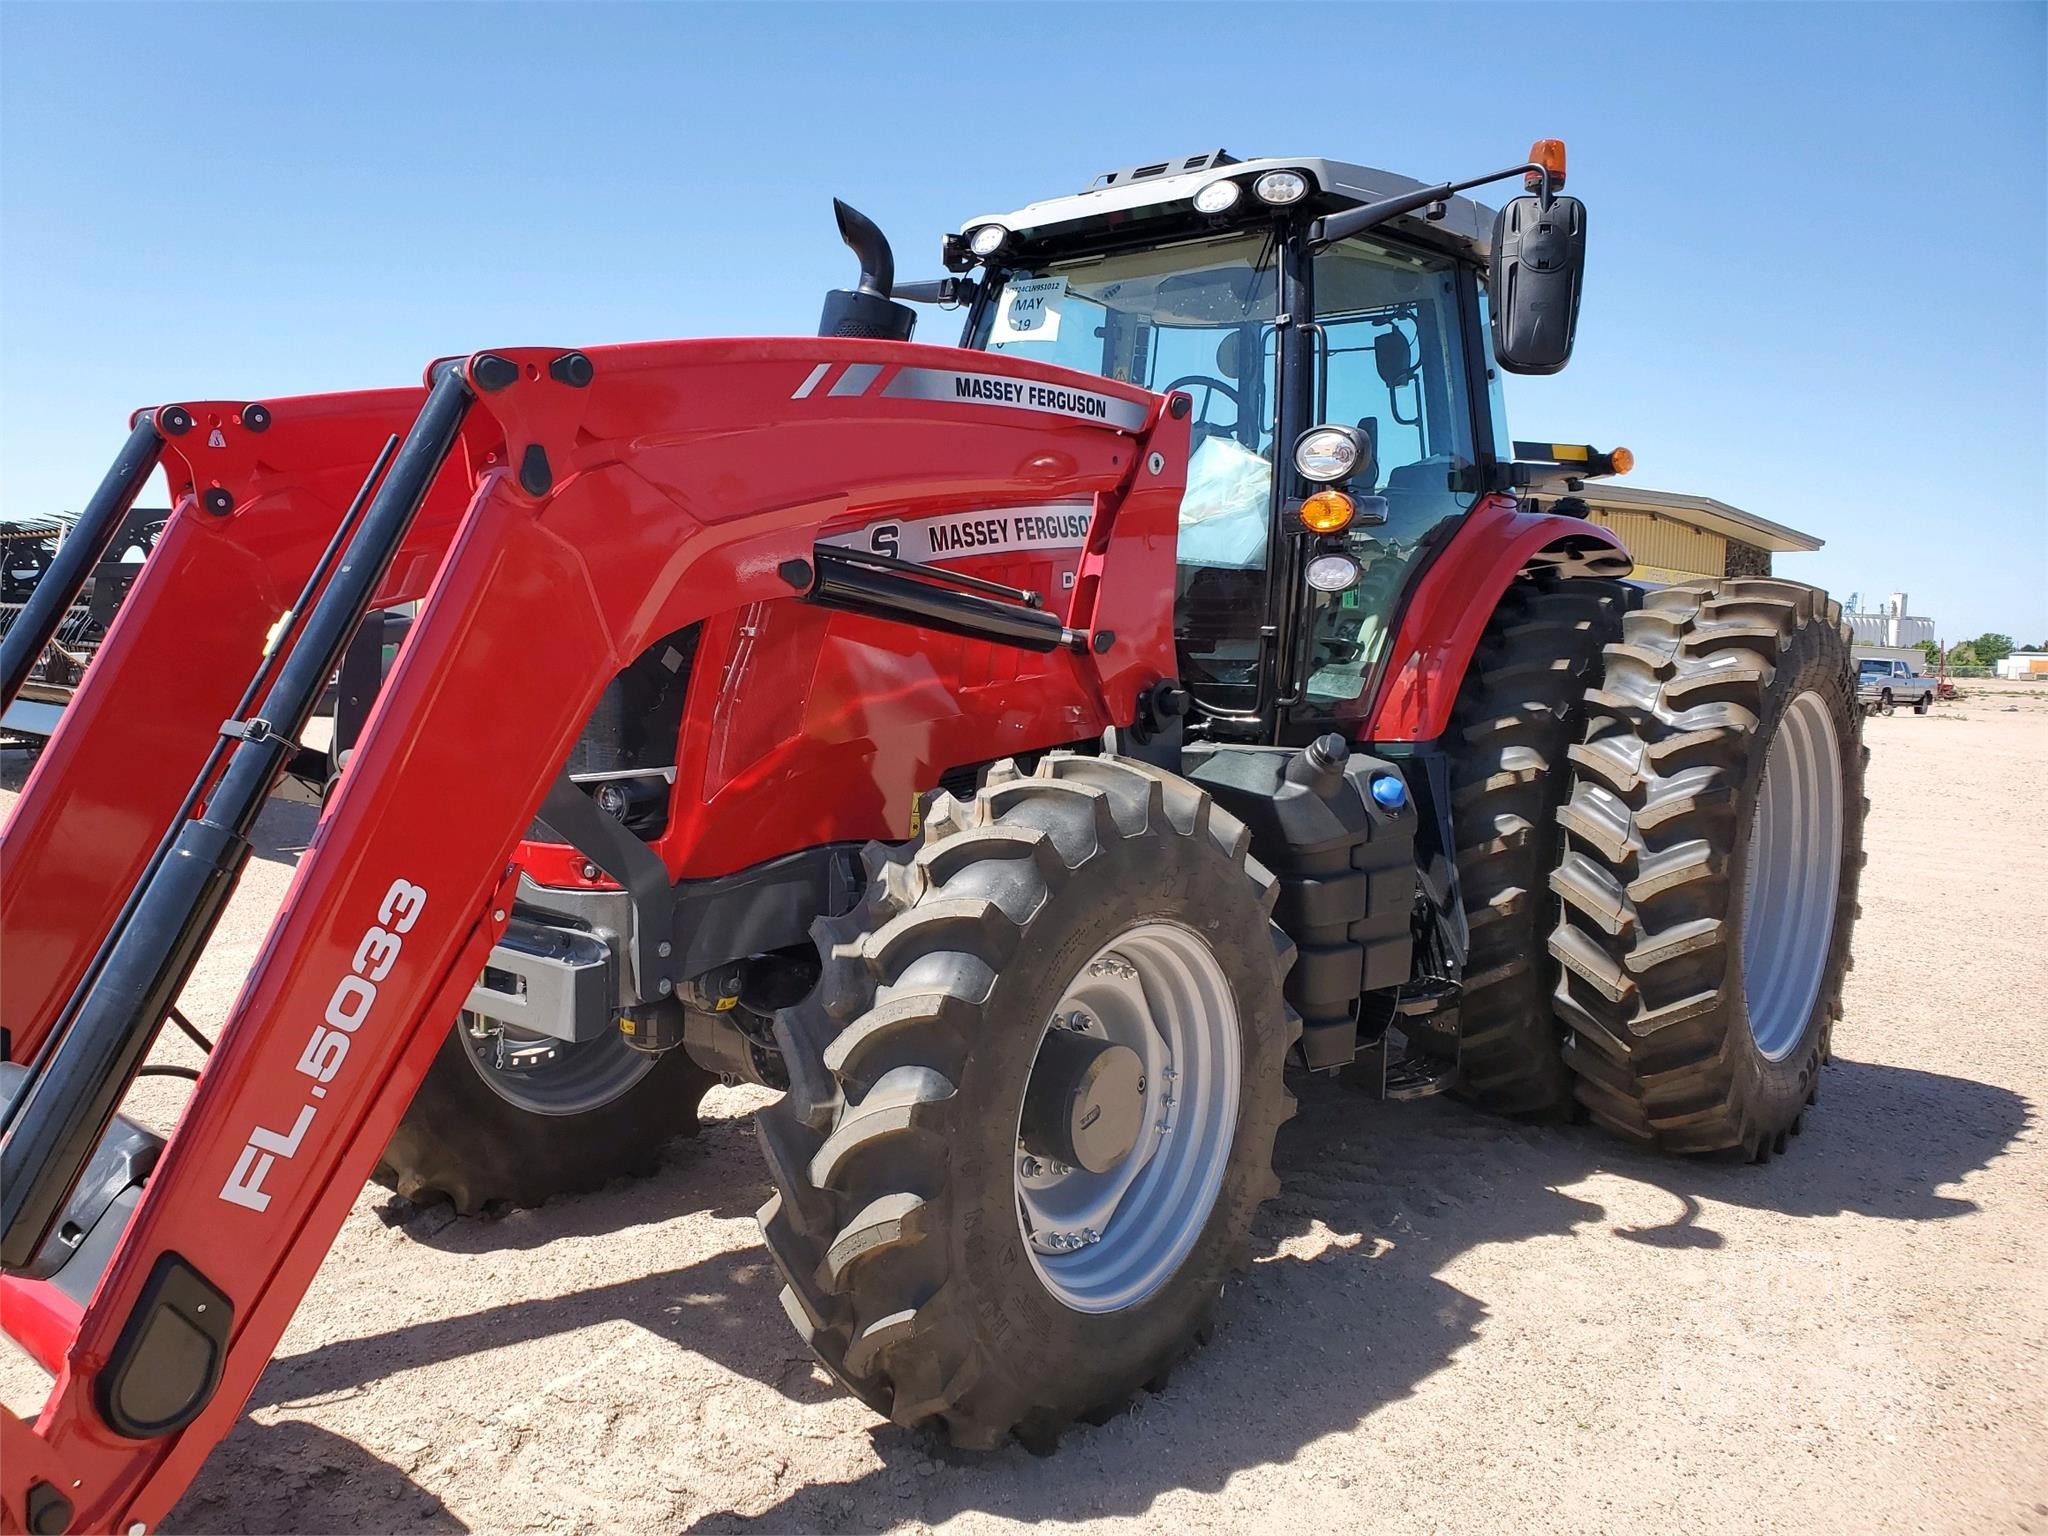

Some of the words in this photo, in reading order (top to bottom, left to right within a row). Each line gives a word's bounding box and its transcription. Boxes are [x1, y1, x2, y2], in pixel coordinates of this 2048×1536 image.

[1015, 297, 1044, 312] MAY
[1018, 318, 1031, 332] 19
[955, 377, 1024, 403] MASSEY
[1028, 386, 1106, 418] FERGUSON
[928, 518, 1008, 552] MASSEY
[1014, 515, 1092, 541] FERGUSO
[218, 878, 428, 1213] FL.5033
